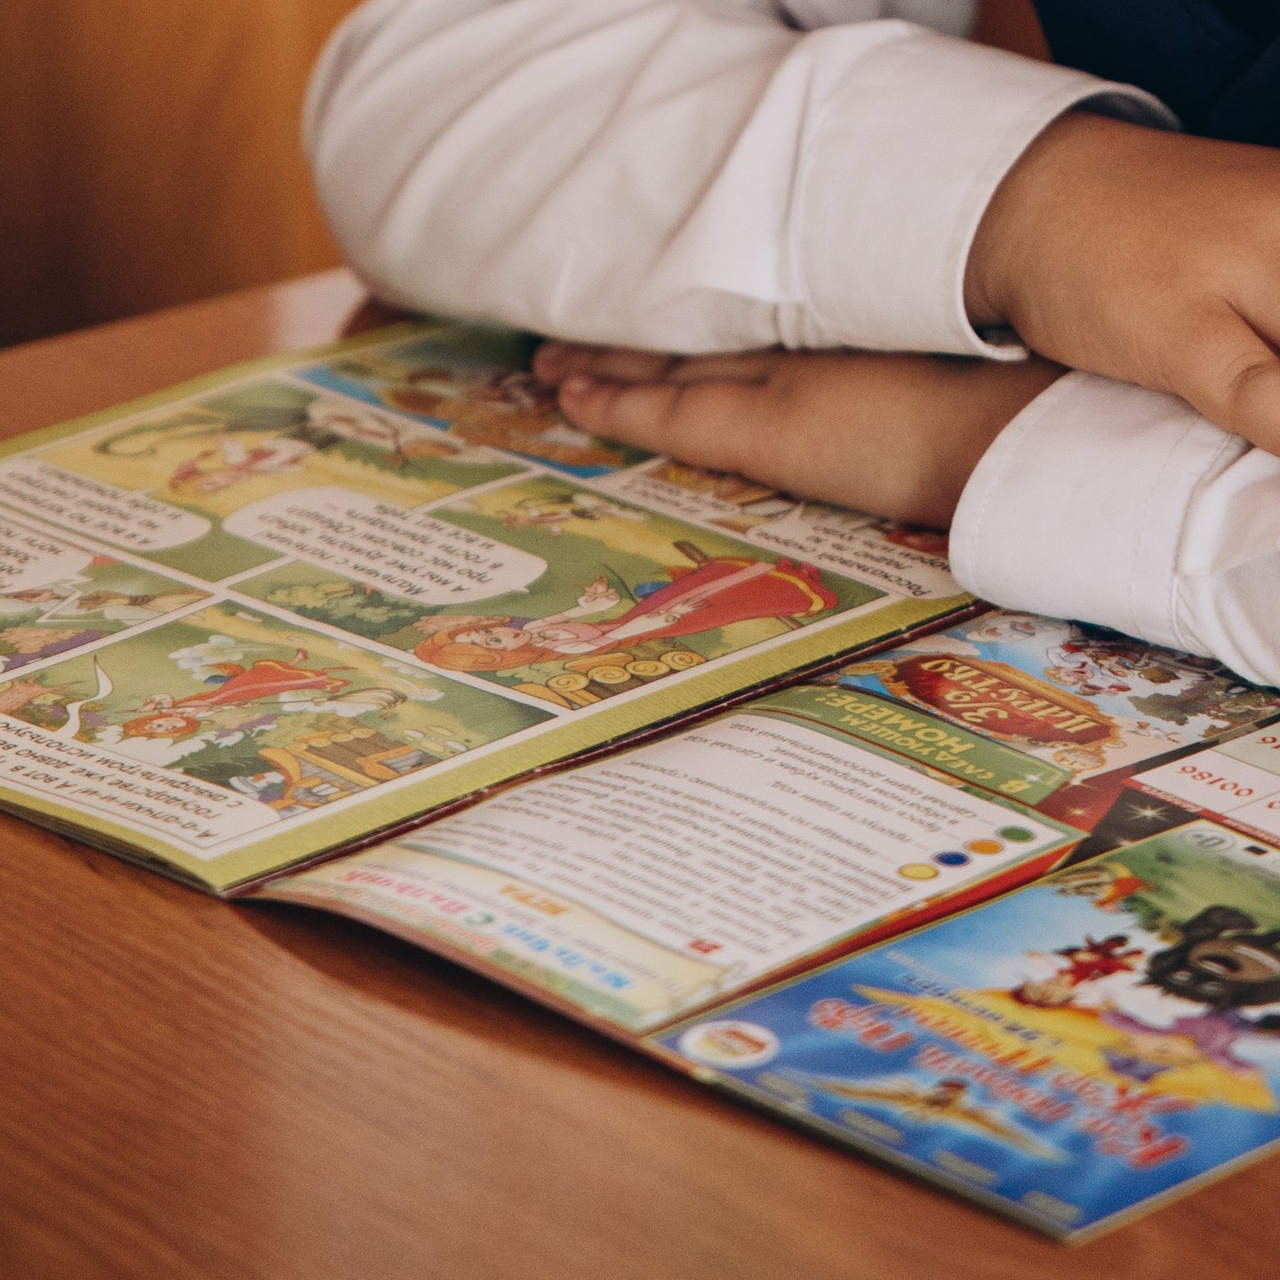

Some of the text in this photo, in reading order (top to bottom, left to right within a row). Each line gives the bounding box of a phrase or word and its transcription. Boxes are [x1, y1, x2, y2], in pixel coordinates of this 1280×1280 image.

[342, 509, 436, 545] приходить
[258, 530, 334, 560] пальчик!
[284, 508, 496, 583] про нас совсем! Обещал
[312, 532, 390, 560] думали,
[436, 544, 487, 564] гости
[852, 550, 910, 570] ладно
[349, 564, 428, 595] Мальчик
[382, 558, 424, 574] уже
[815, 552, 933, 596] Рассказывай
[913, 653, 1104, 734] ЦАРСТВО
[940, 690, 1012, 725] 3/9
[814, 690, 976, 754] НОМЕРЕ:
[1, 722, 96, 758] использую
[753, 730, 886, 779] дополнительный
[836, 714, 996, 780] СЛЕДУЮЩЕМ
[12, 749, 74, 769] давно
[68, 767, 112, 781] уже
[773, 761, 822, 781] кубик
[21, 770, 60, 783] вот
[94, 756, 230, 802] аквафильтром
[880, 778, 924, 796] один
[1176, 765, 1256, 797] 00186
[68, 786, 218, 839] А-а-апчхи-и-и!
[105, 779, 218, 818] государстве
[870, 786, 948, 820] обратном
[920, 794, 978, 818] сделай
